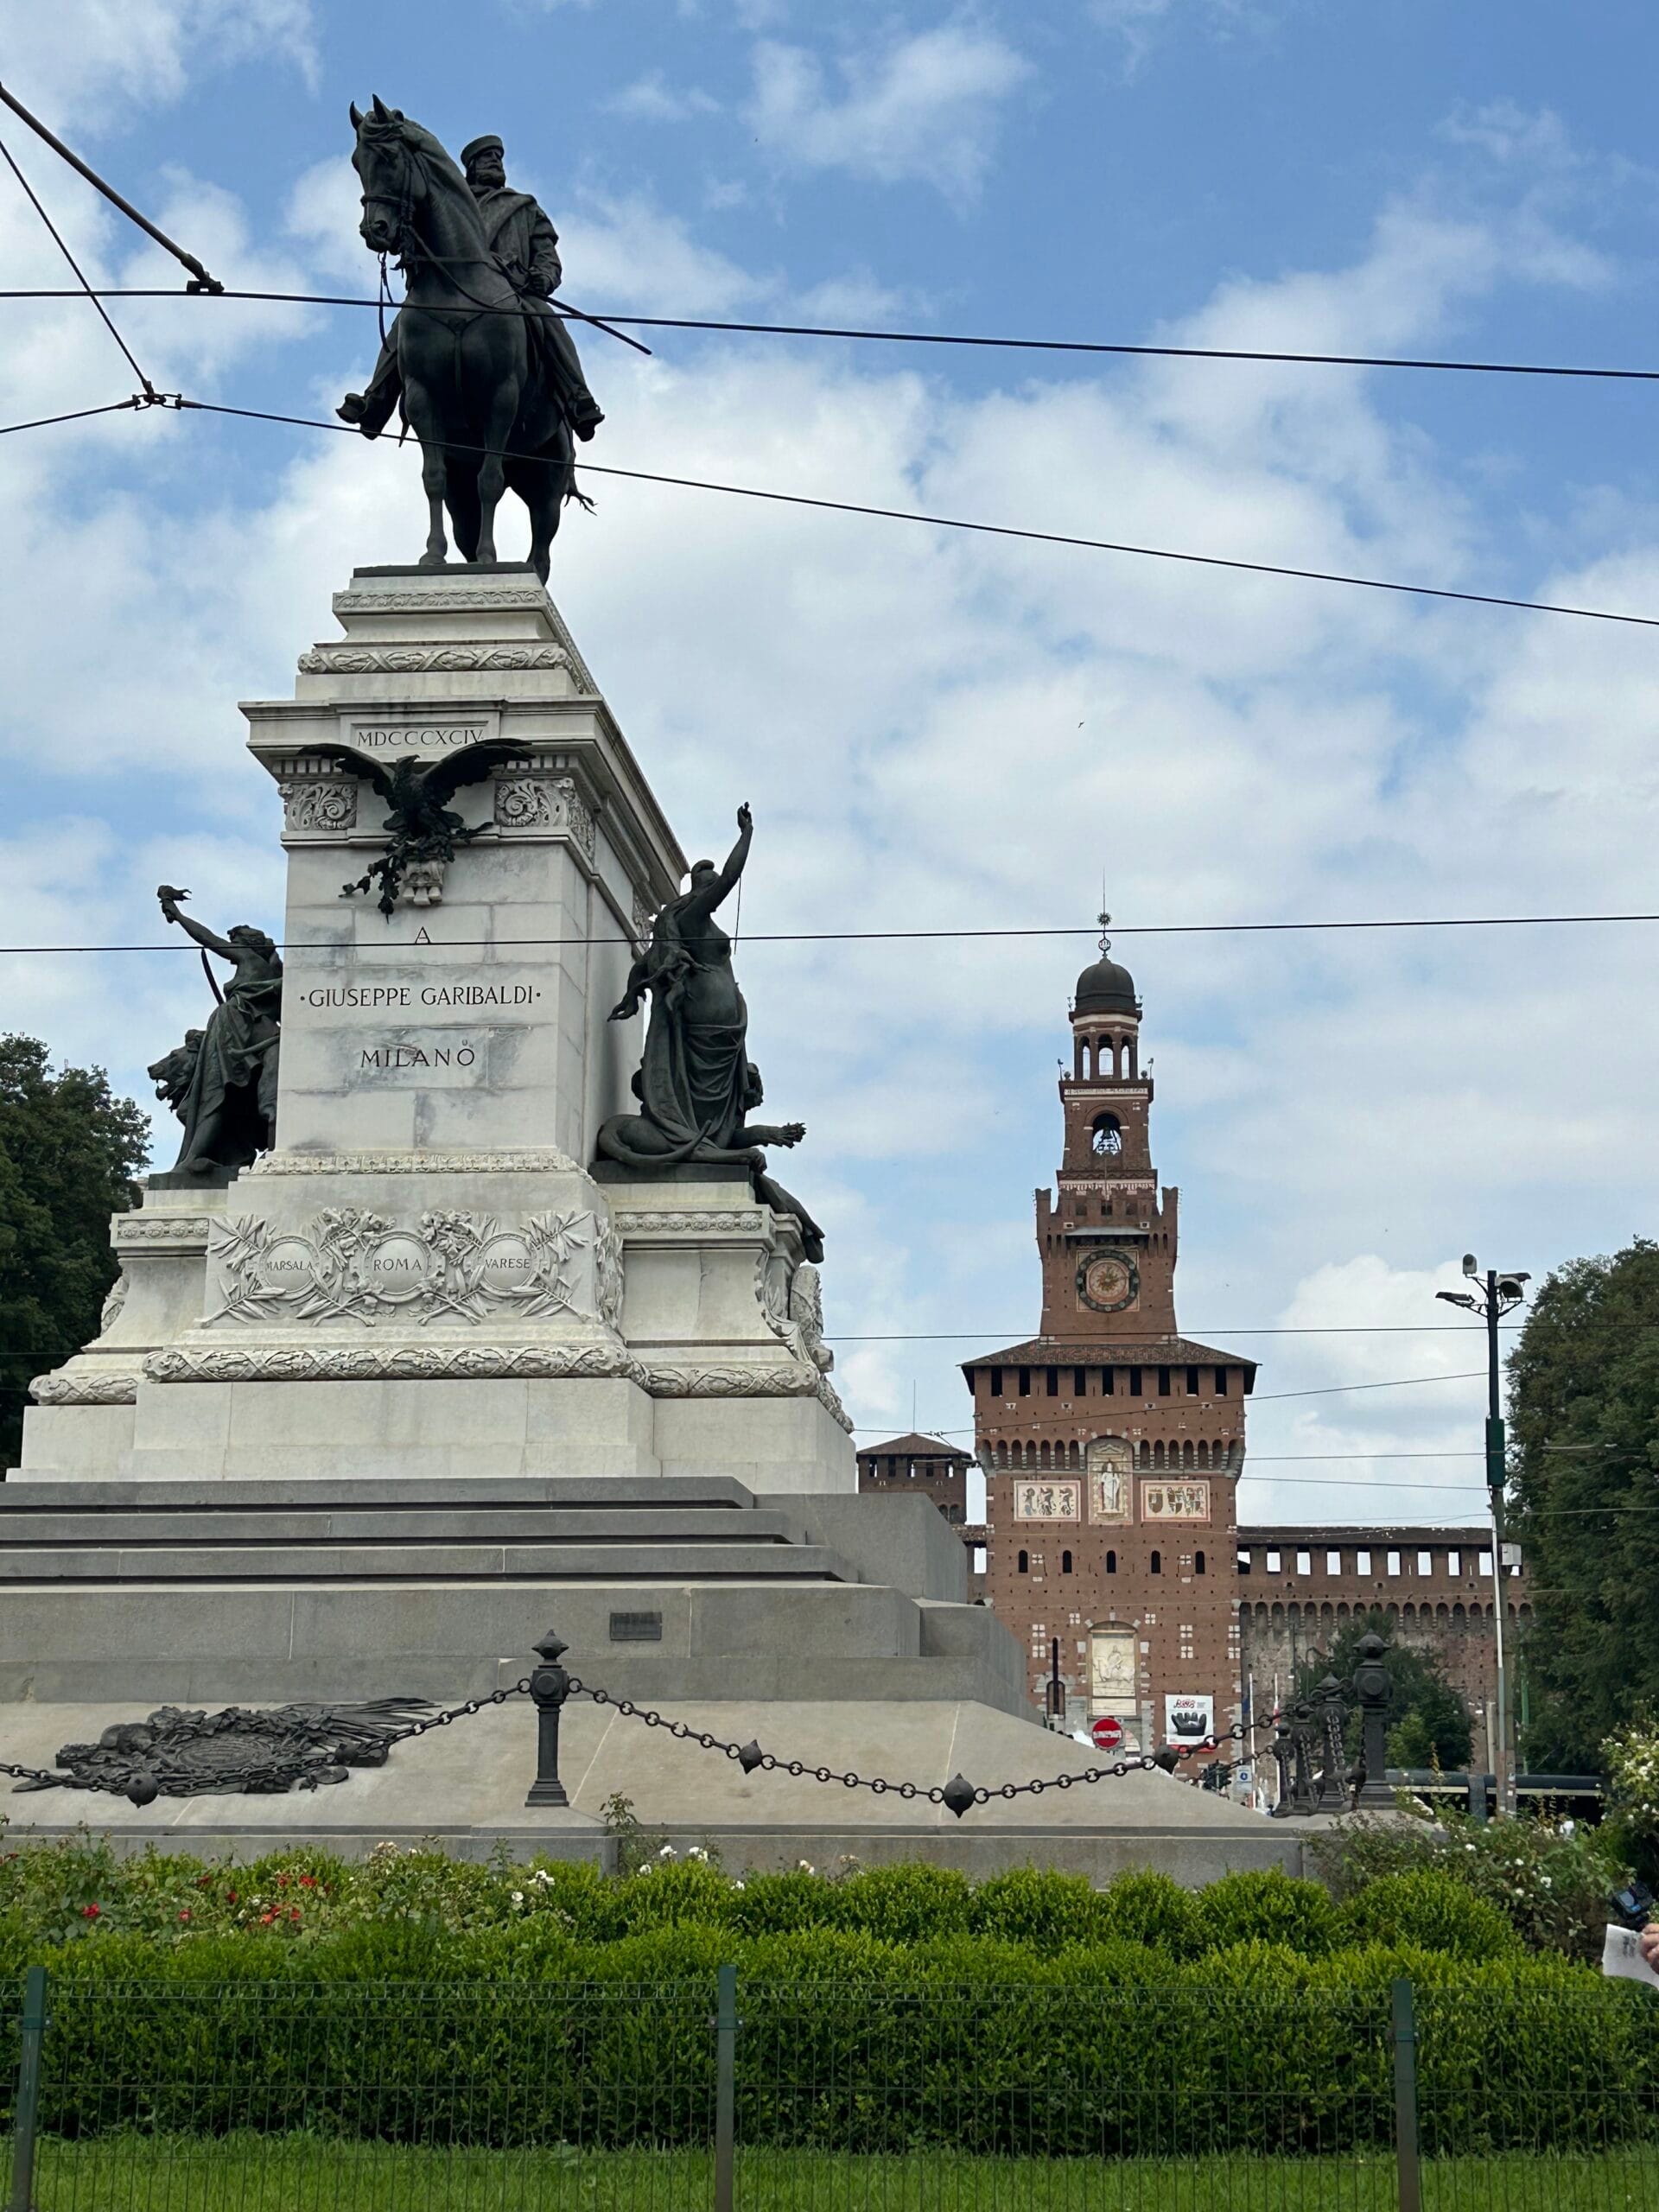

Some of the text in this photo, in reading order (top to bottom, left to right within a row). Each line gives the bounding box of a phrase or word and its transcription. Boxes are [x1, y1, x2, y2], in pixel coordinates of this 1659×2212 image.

[414, 926, 432, 944] A
[360, 1048, 475, 1068] MILANO
[265, 1261, 315, 1271] MARSALA
[373, 1258, 423, 1271] ROMA
[485, 1258, 531, 1268] VARESE
